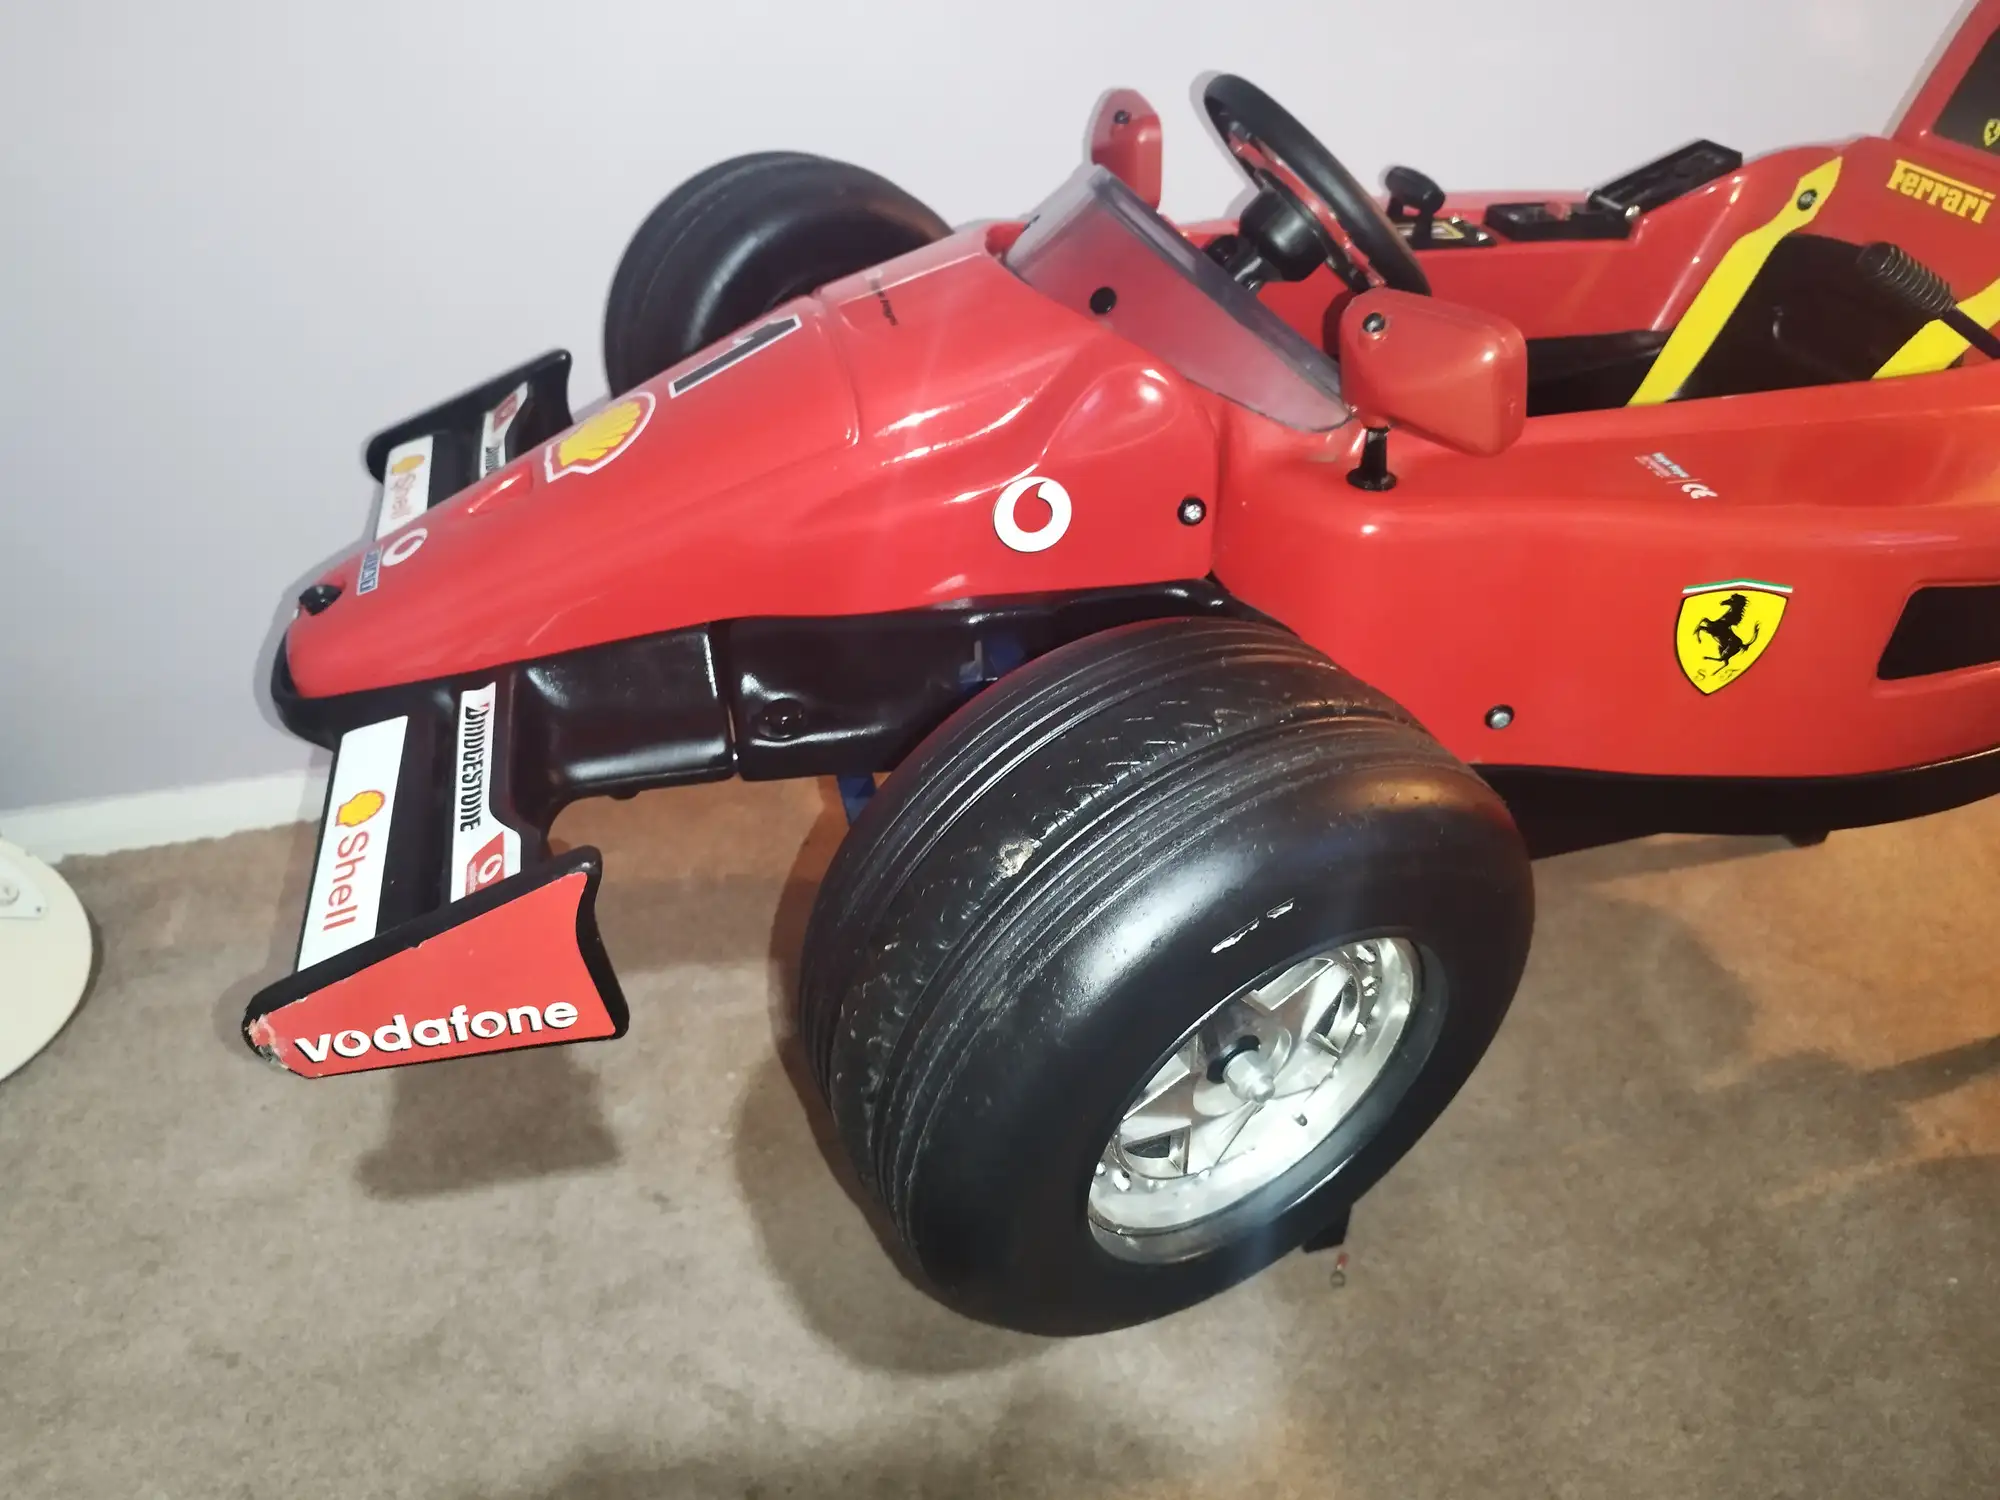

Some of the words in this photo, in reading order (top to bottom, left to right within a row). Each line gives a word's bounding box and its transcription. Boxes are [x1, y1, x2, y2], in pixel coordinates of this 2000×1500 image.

[1886, 158, 1996, 224] Ferrari
[460, 703, 490, 833] BRIDGESTONE
[323, 831, 369, 931] Shell
[295, 1001, 579, 1063] vodafone
